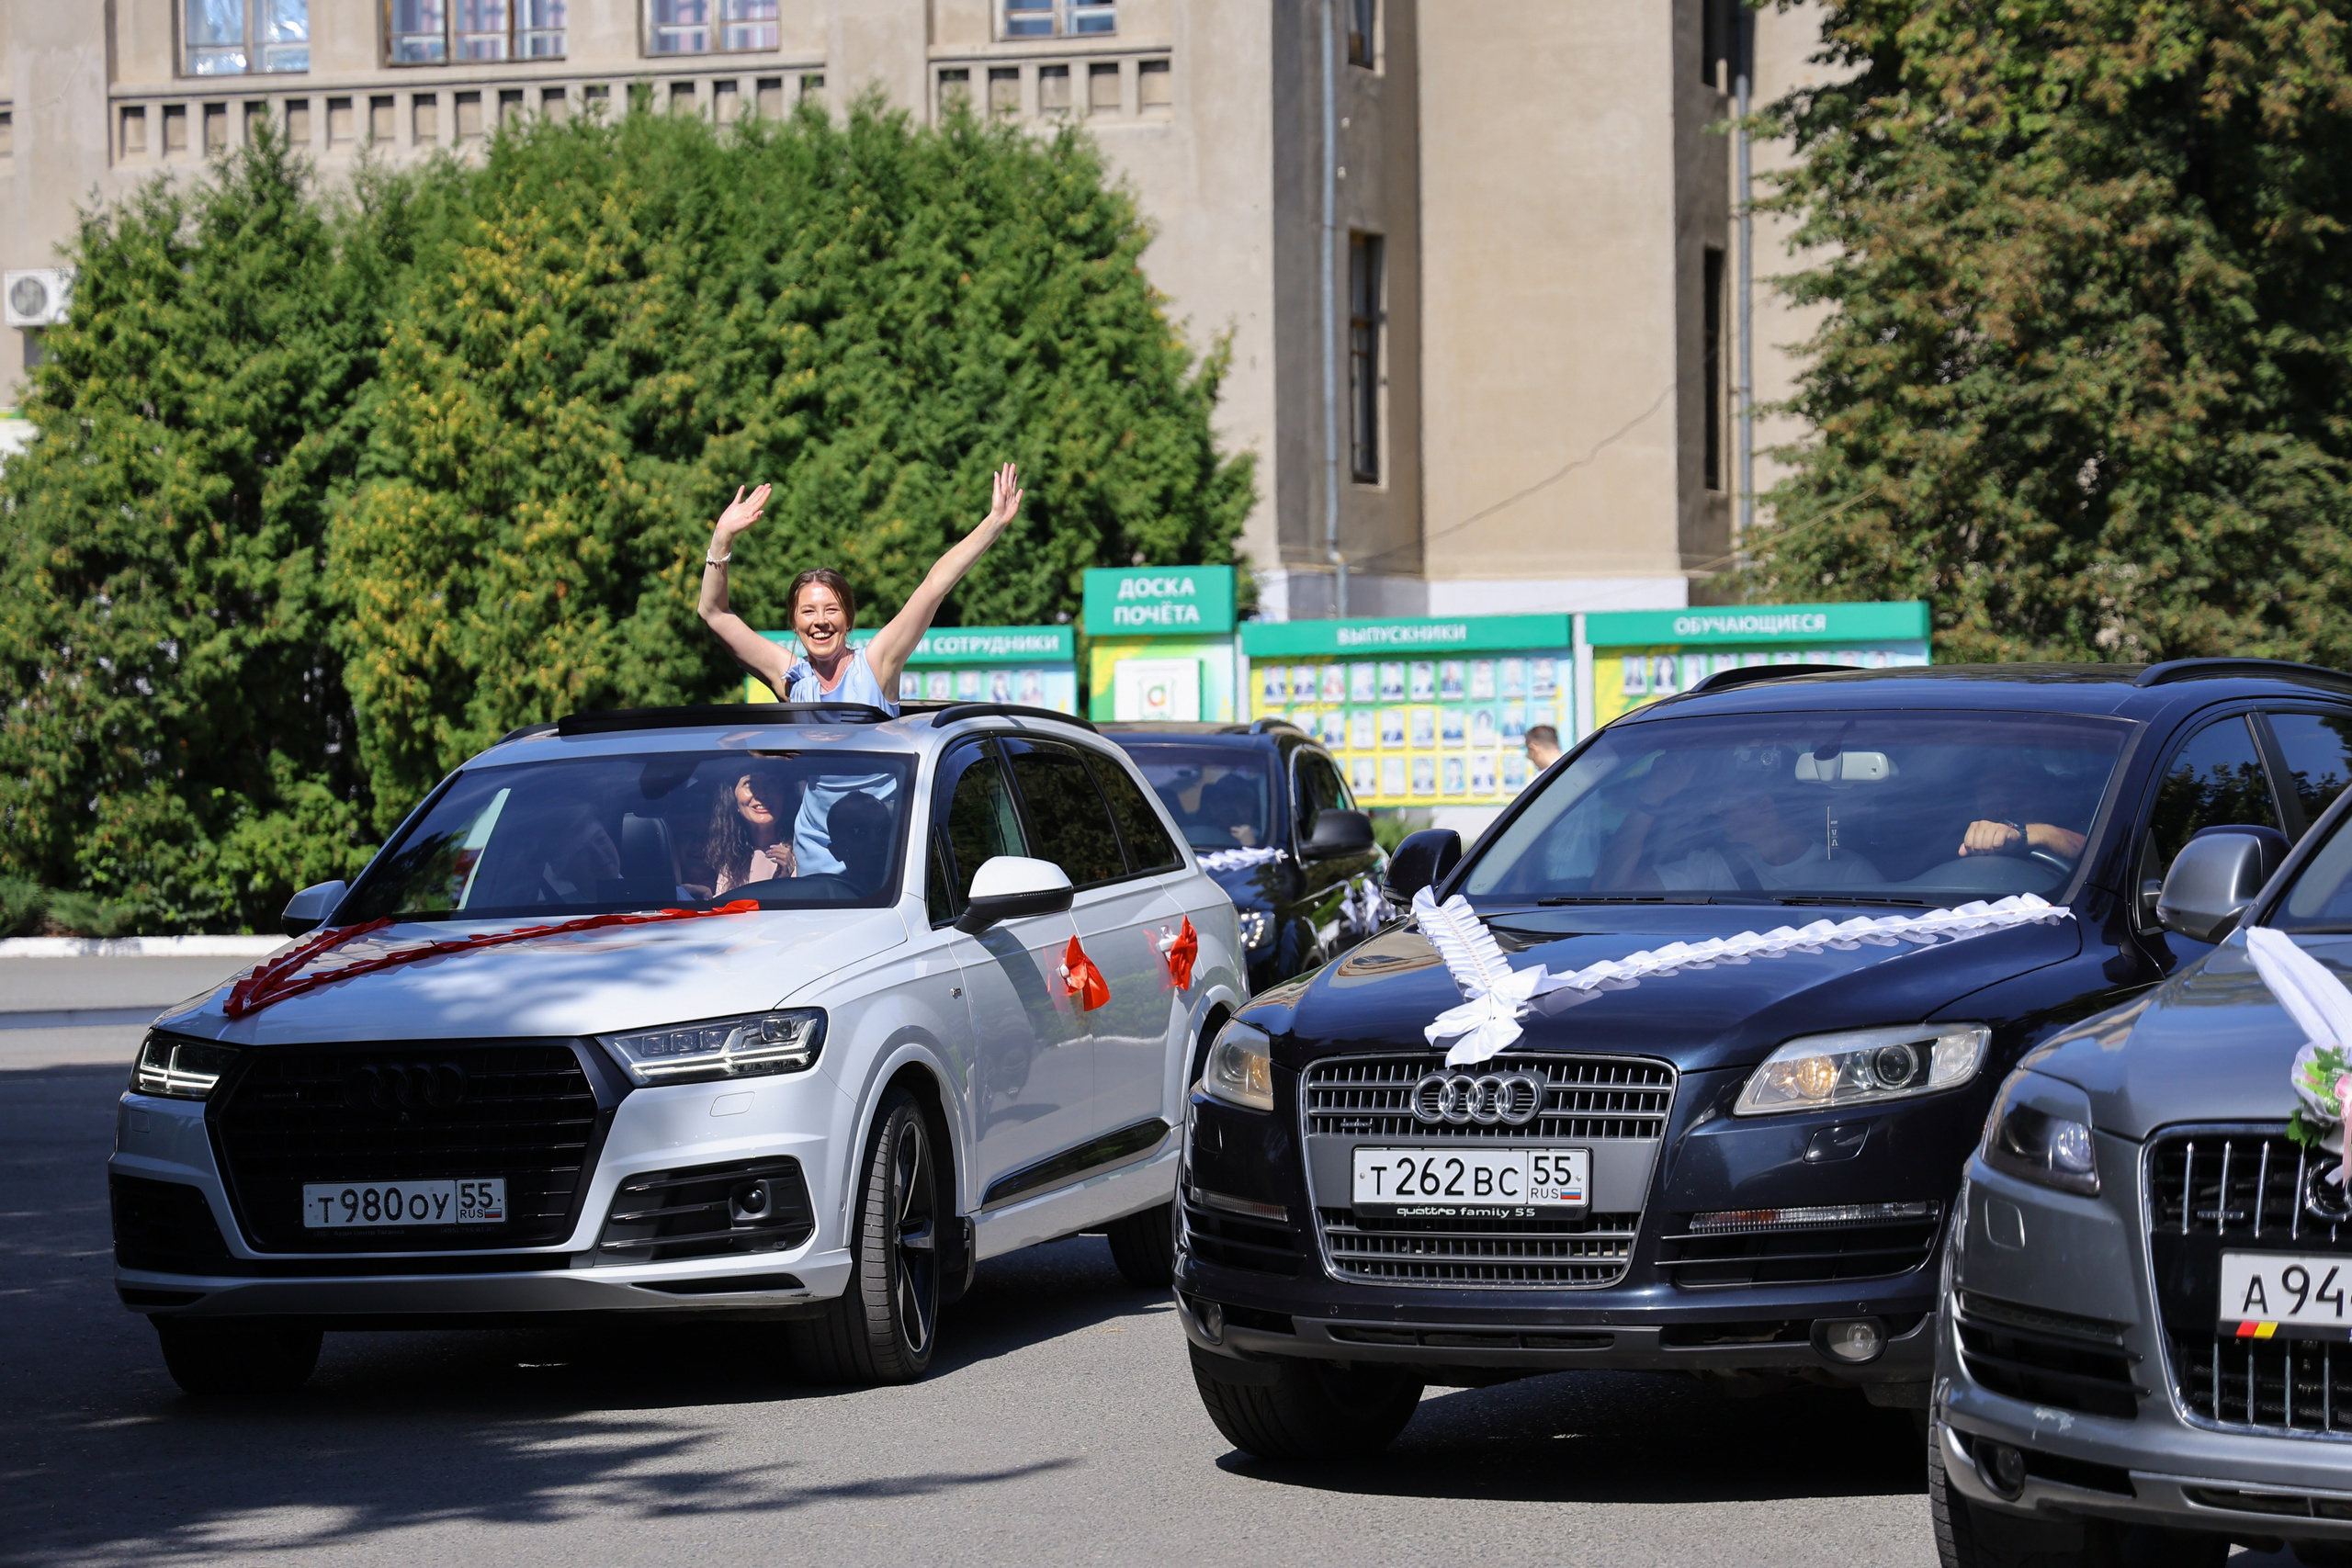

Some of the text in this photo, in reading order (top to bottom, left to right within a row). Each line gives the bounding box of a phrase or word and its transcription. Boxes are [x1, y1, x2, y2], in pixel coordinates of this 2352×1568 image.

[1118, 577, 1196, 601] ДОСКА
[1113, 601, 1201, 626] ПОЧЁТА
[1337, 624, 1466, 646] ВЫПУСКНИКИ
[1673, 614, 1826, 636] ОБУЧАЮЩИЕСЯ
[933, 635, 1060, 657] СОТРУДНИКИ
[1532, 1156, 1572, 1186] 55
[460, 1182, 493, 1209] 55
[1531, 1188, 1559, 1200] RUS
[459, 1208, 484, 1218] RUS
[1396, 1206, 1536, 1218] quattro family 55
[2243, 1264, 2352, 1318] А94
